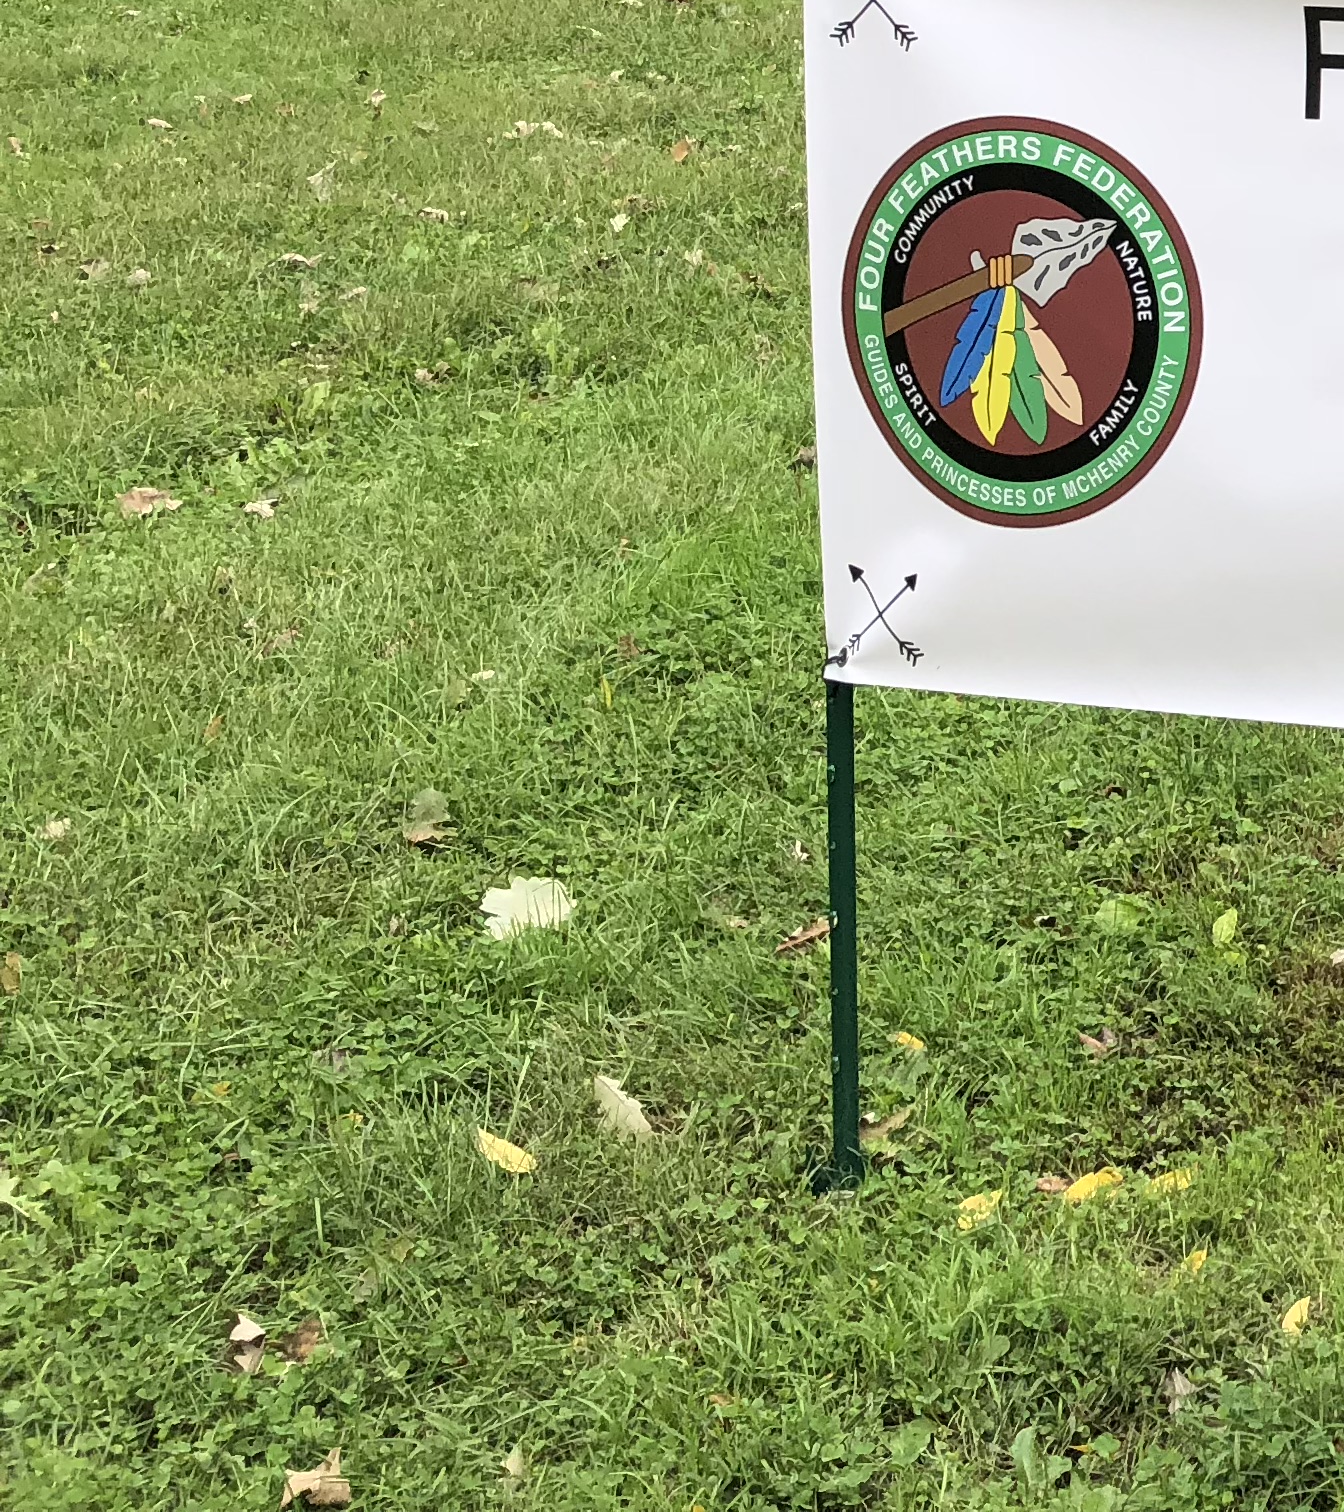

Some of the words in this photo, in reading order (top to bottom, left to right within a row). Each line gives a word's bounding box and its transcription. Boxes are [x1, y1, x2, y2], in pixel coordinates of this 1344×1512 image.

[858, 216, 895, 313] FOUR
[888, 135, 1042, 215] FEATHERS
[1052, 143, 1186, 333] FEDERATION
[894, 174, 976, 264] COMMUNITY
[1115, 240, 1154, 323] NATURE
[864, 333, 899, 410] GUIDES
[892, 411, 924, 451] AND
[921, 445, 1028, 508] PRINCESSES
[1032, 484, 1058, 507] OF
[1063, 433, 1142, 502] MCHENRY
[1139, 354, 1180, 437] COUNTY
[894, 362, 938, 428] SPIRIT
[1088, 378, 1140, 448] FAMILY
